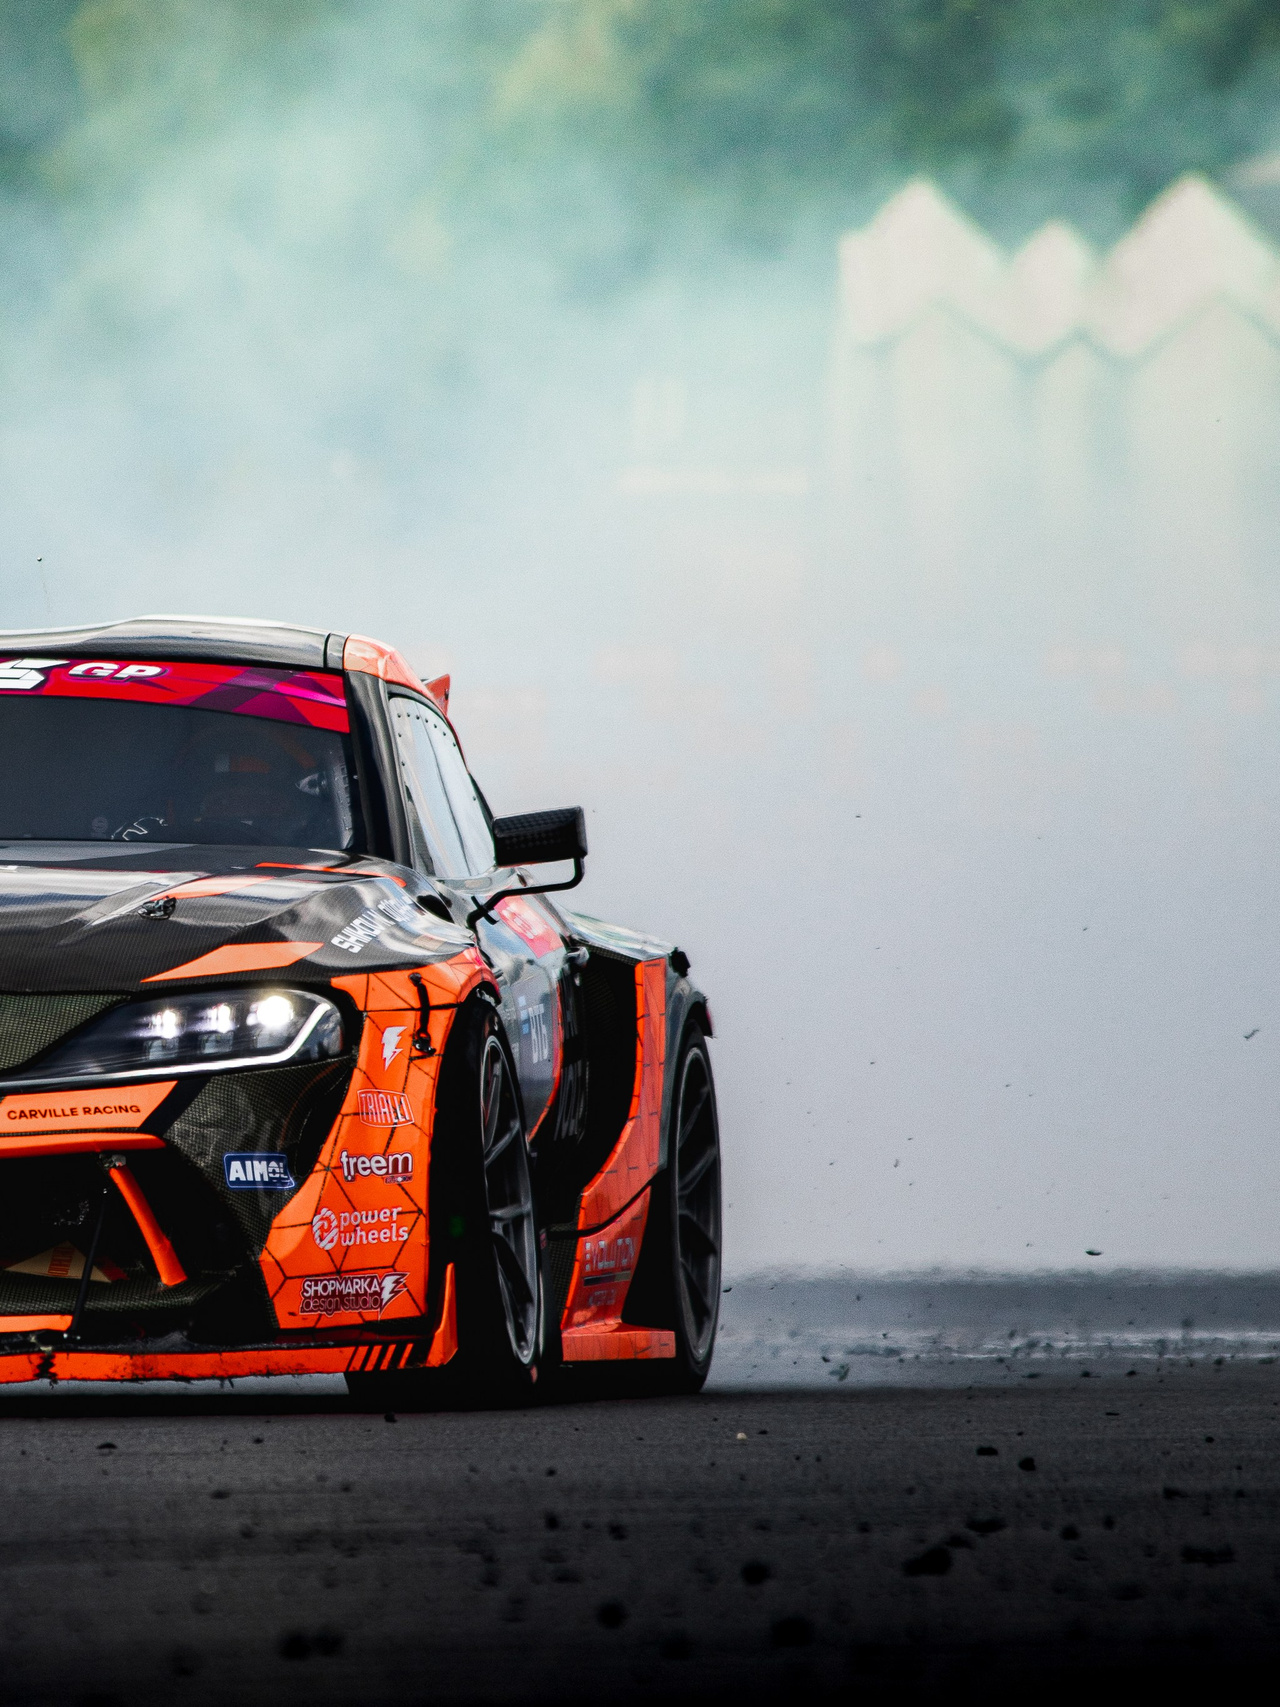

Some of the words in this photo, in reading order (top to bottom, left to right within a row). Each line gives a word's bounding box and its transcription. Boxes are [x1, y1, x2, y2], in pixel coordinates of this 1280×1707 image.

[68, 662, 164, 680] GP
[7, 1107, 79, 1121] CARVILLE
[83, 1105, 141, 1116] RACING
[360, 1093, 410, 1124] TRIALLI
[340, 1151, 413, 1181] freem
[340, 1206, 403, 1231] power
[340, 1223, 408, 1247] wheels
[303, 1277, 381, 1297] SHOPMARKA
[303, 1295, 340, 1314] design
[344, 1293, 380, 1309] studio
